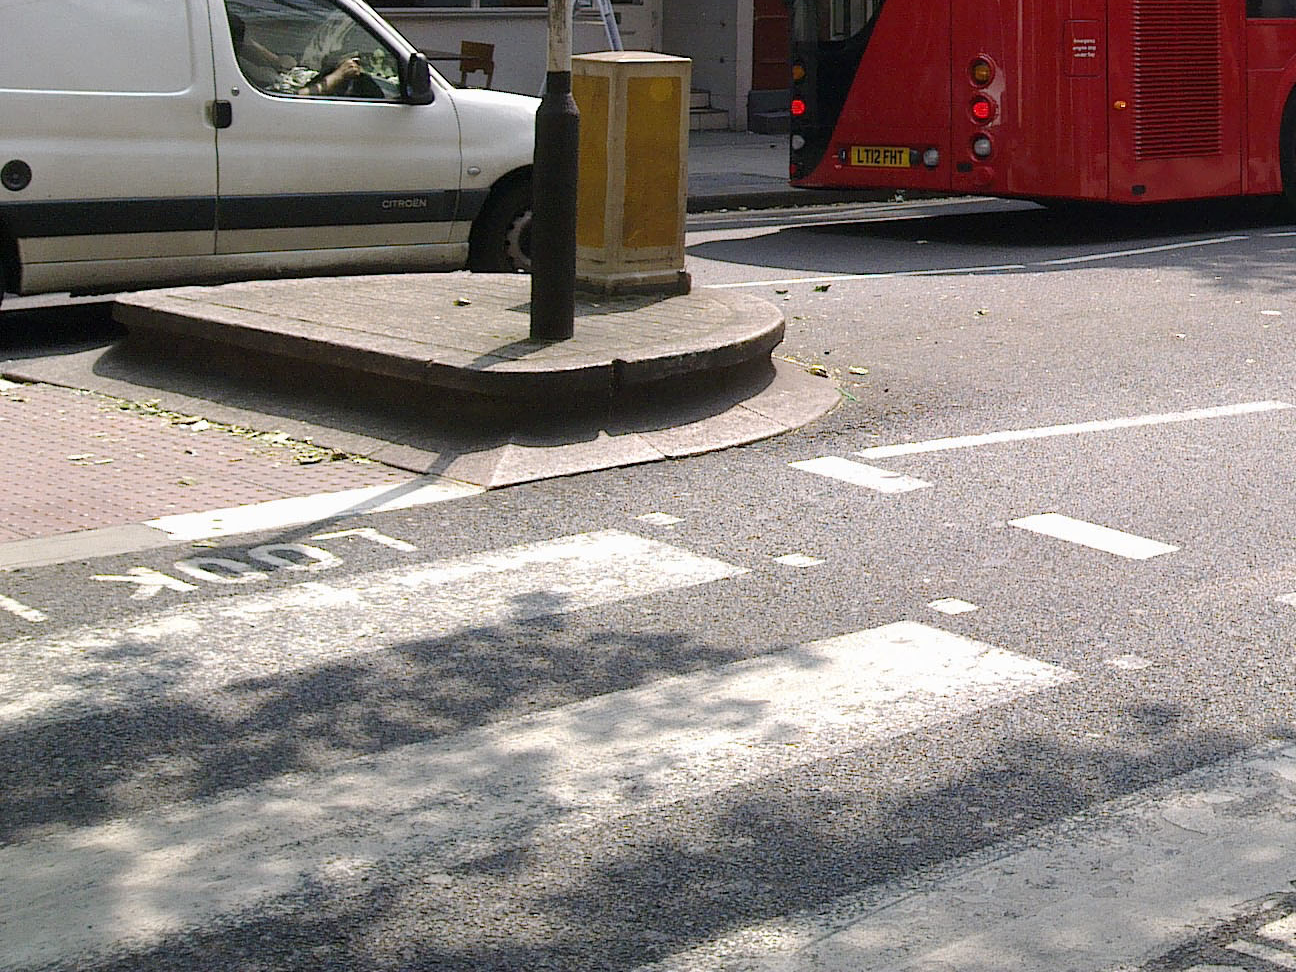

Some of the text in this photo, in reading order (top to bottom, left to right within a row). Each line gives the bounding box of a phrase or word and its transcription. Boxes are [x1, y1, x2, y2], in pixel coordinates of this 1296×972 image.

[857, 148, 904, 165] LT12 FHT
[90, 528, 417, 600] LOOK
